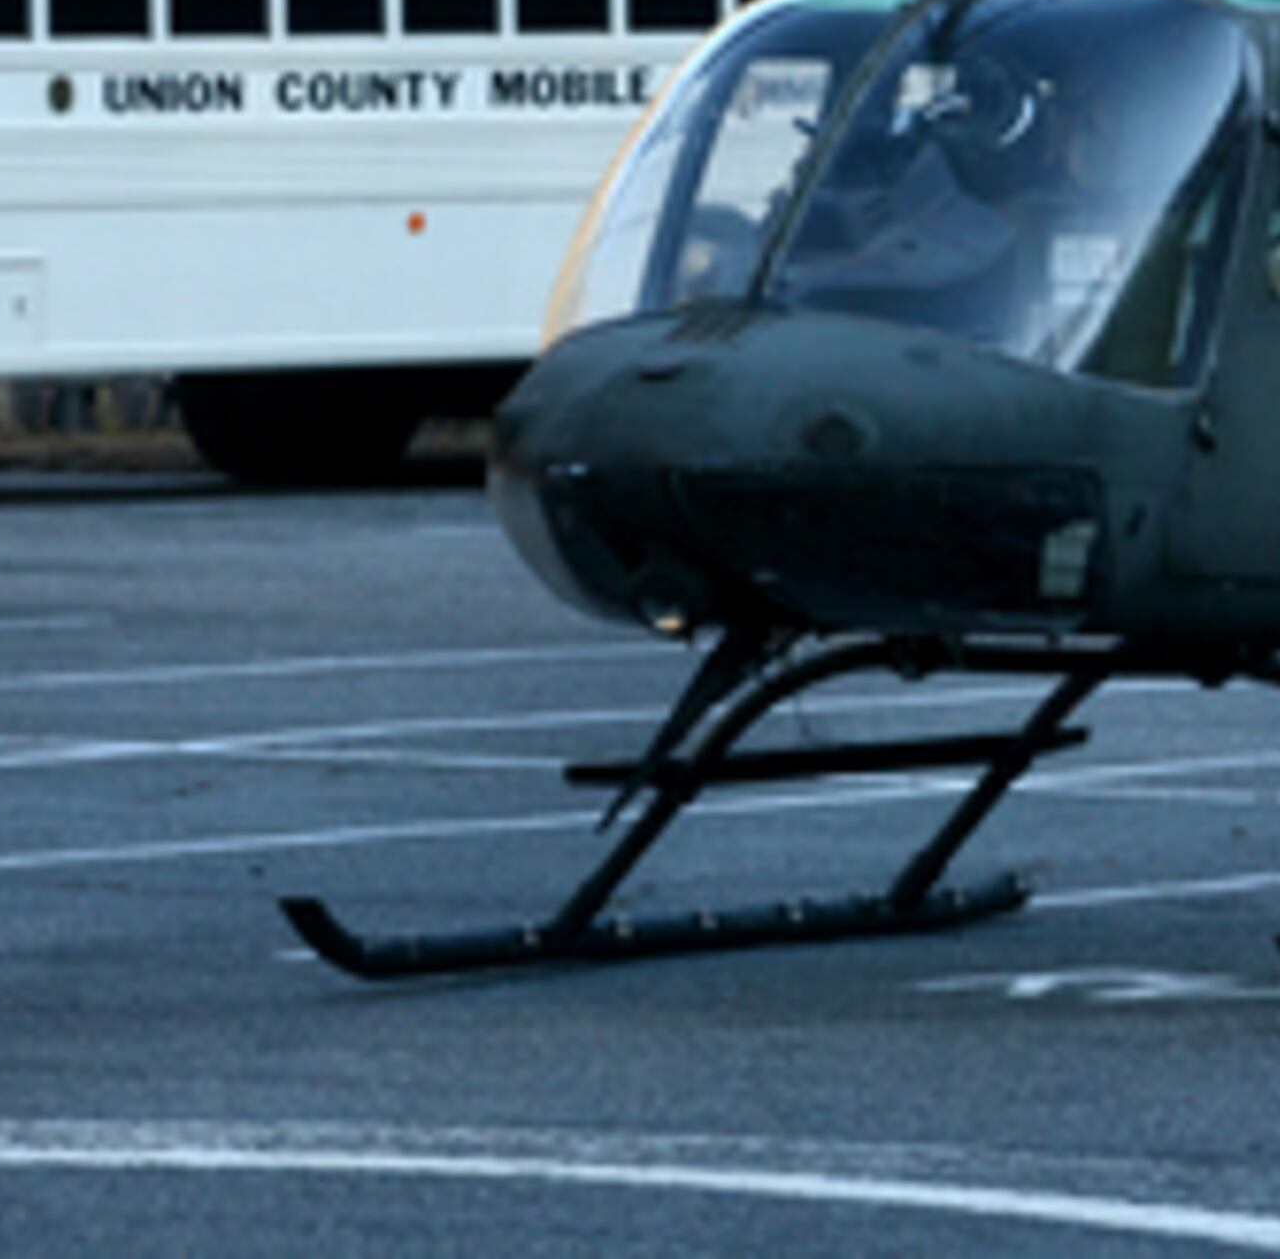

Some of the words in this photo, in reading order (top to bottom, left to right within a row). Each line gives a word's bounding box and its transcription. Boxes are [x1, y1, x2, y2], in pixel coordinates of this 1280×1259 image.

[102, 72, 242, 113] UNION
[276, 70, 460, 112] COUNTY
[488, 66, 652, 108] MOBILE
